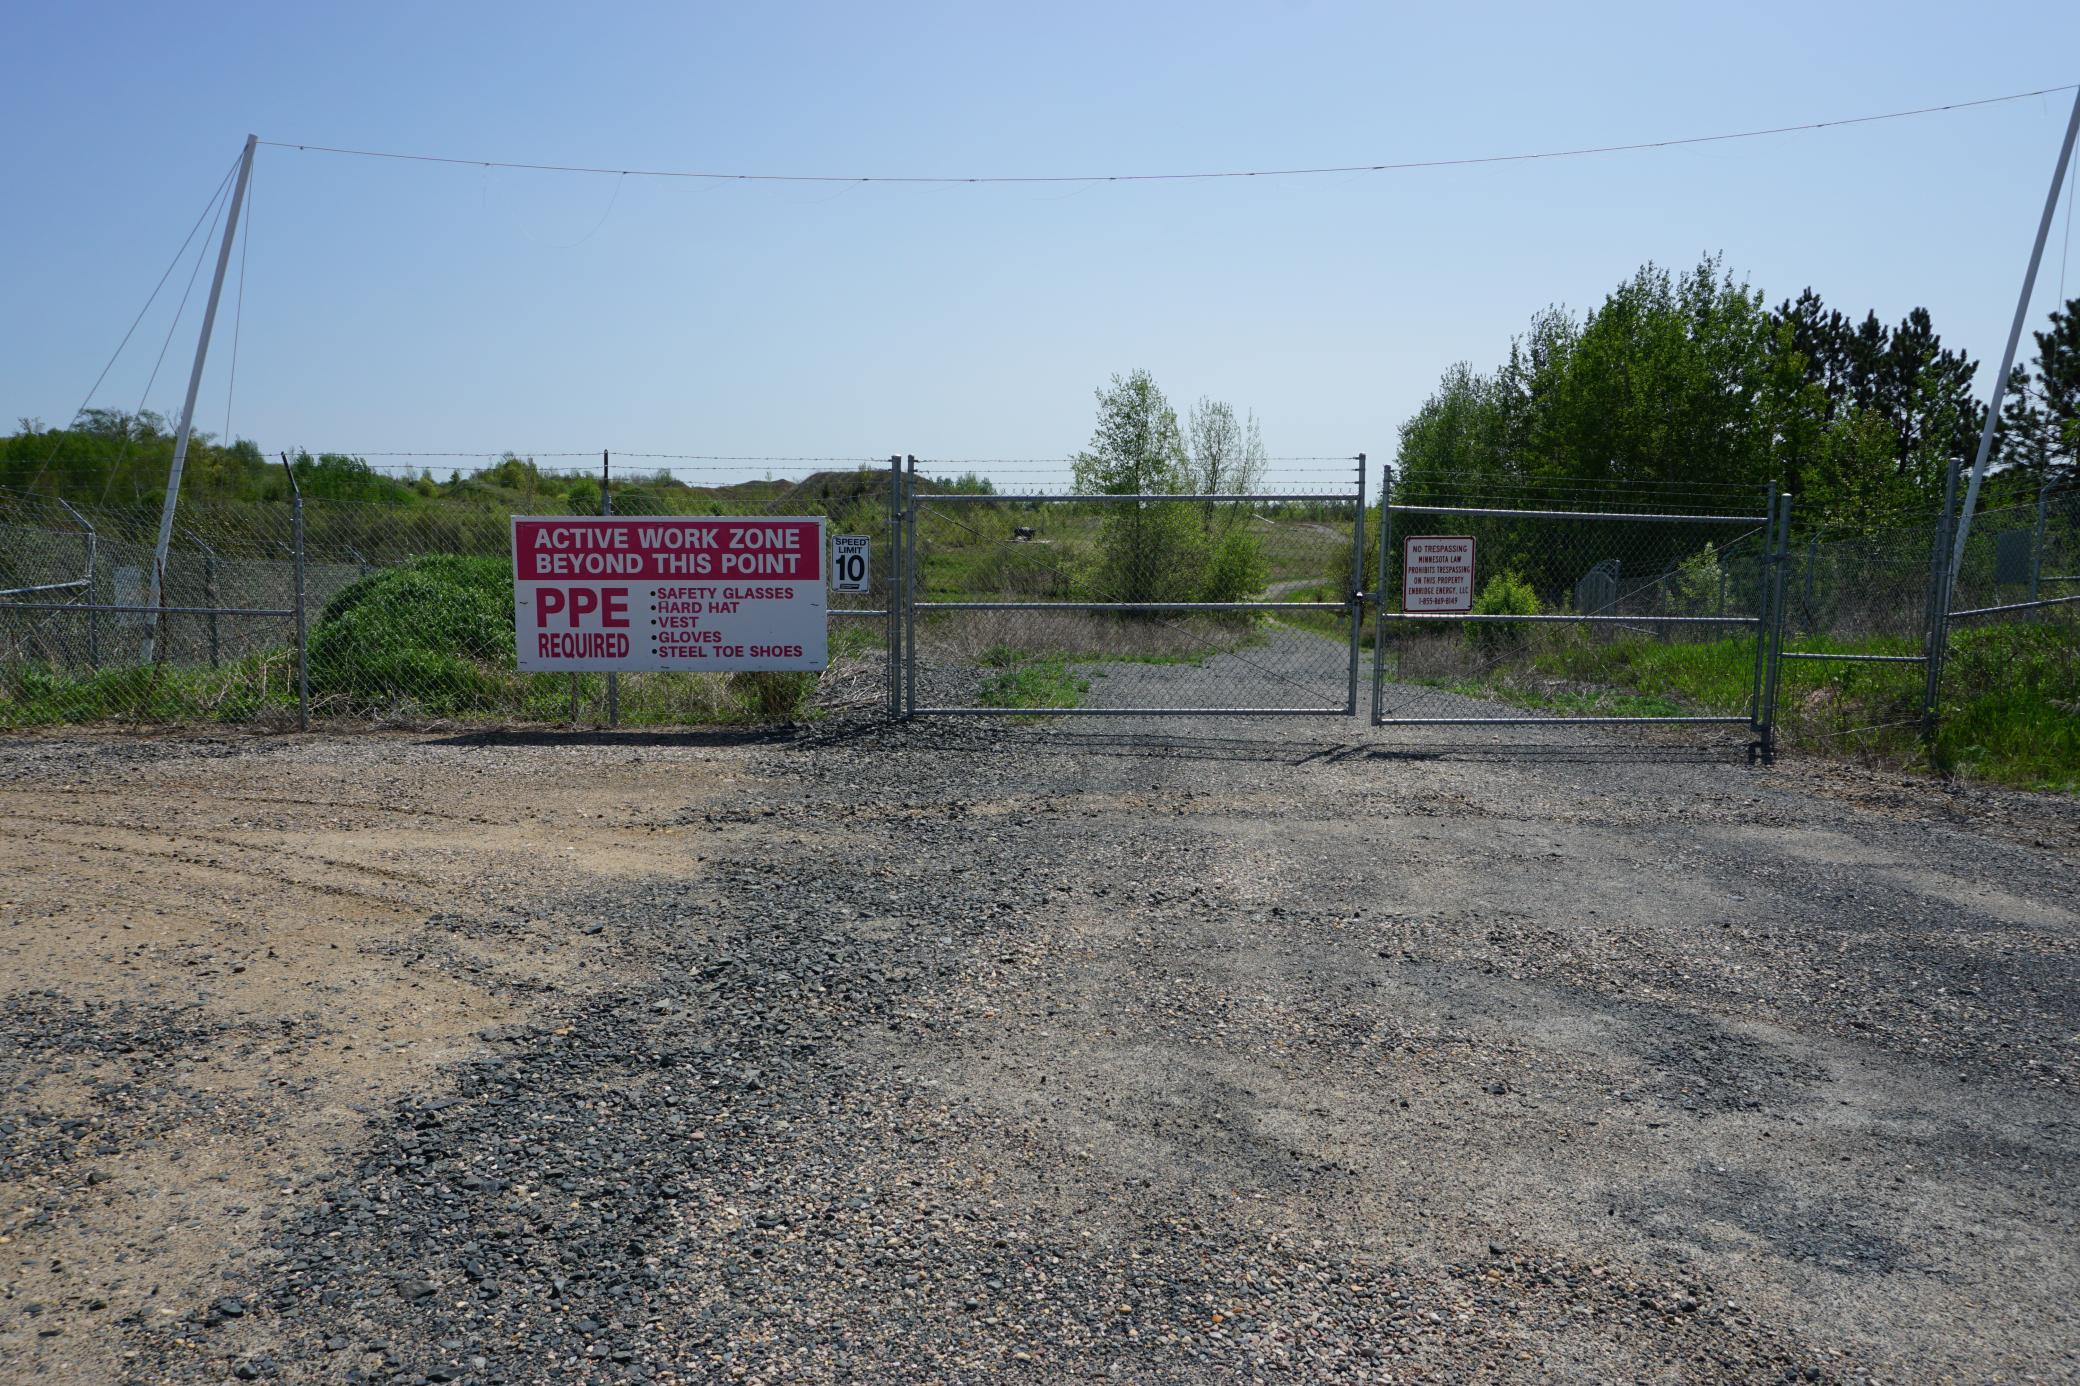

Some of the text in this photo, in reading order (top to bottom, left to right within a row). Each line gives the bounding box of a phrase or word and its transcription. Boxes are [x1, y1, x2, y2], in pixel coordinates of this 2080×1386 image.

[534, 528, 800, 549] ACTIVE WORK ZONE
[536, 554, 801, 574] BEYOND THIS POINT
[836, 555, 864, 581] 10
[658, 588, 793, 599] SAFETY GLASSES
[536, 588, 630, 628] PPE
[658, 602, 740, 614] HARD HAT
[659, 617, 699, 628] VEST
[538, 633, 629, 658] REQUIRED
[658, 632, 722, 643] GLOVES
[659, 646, 803, 657] STEEL TOE SHOES
